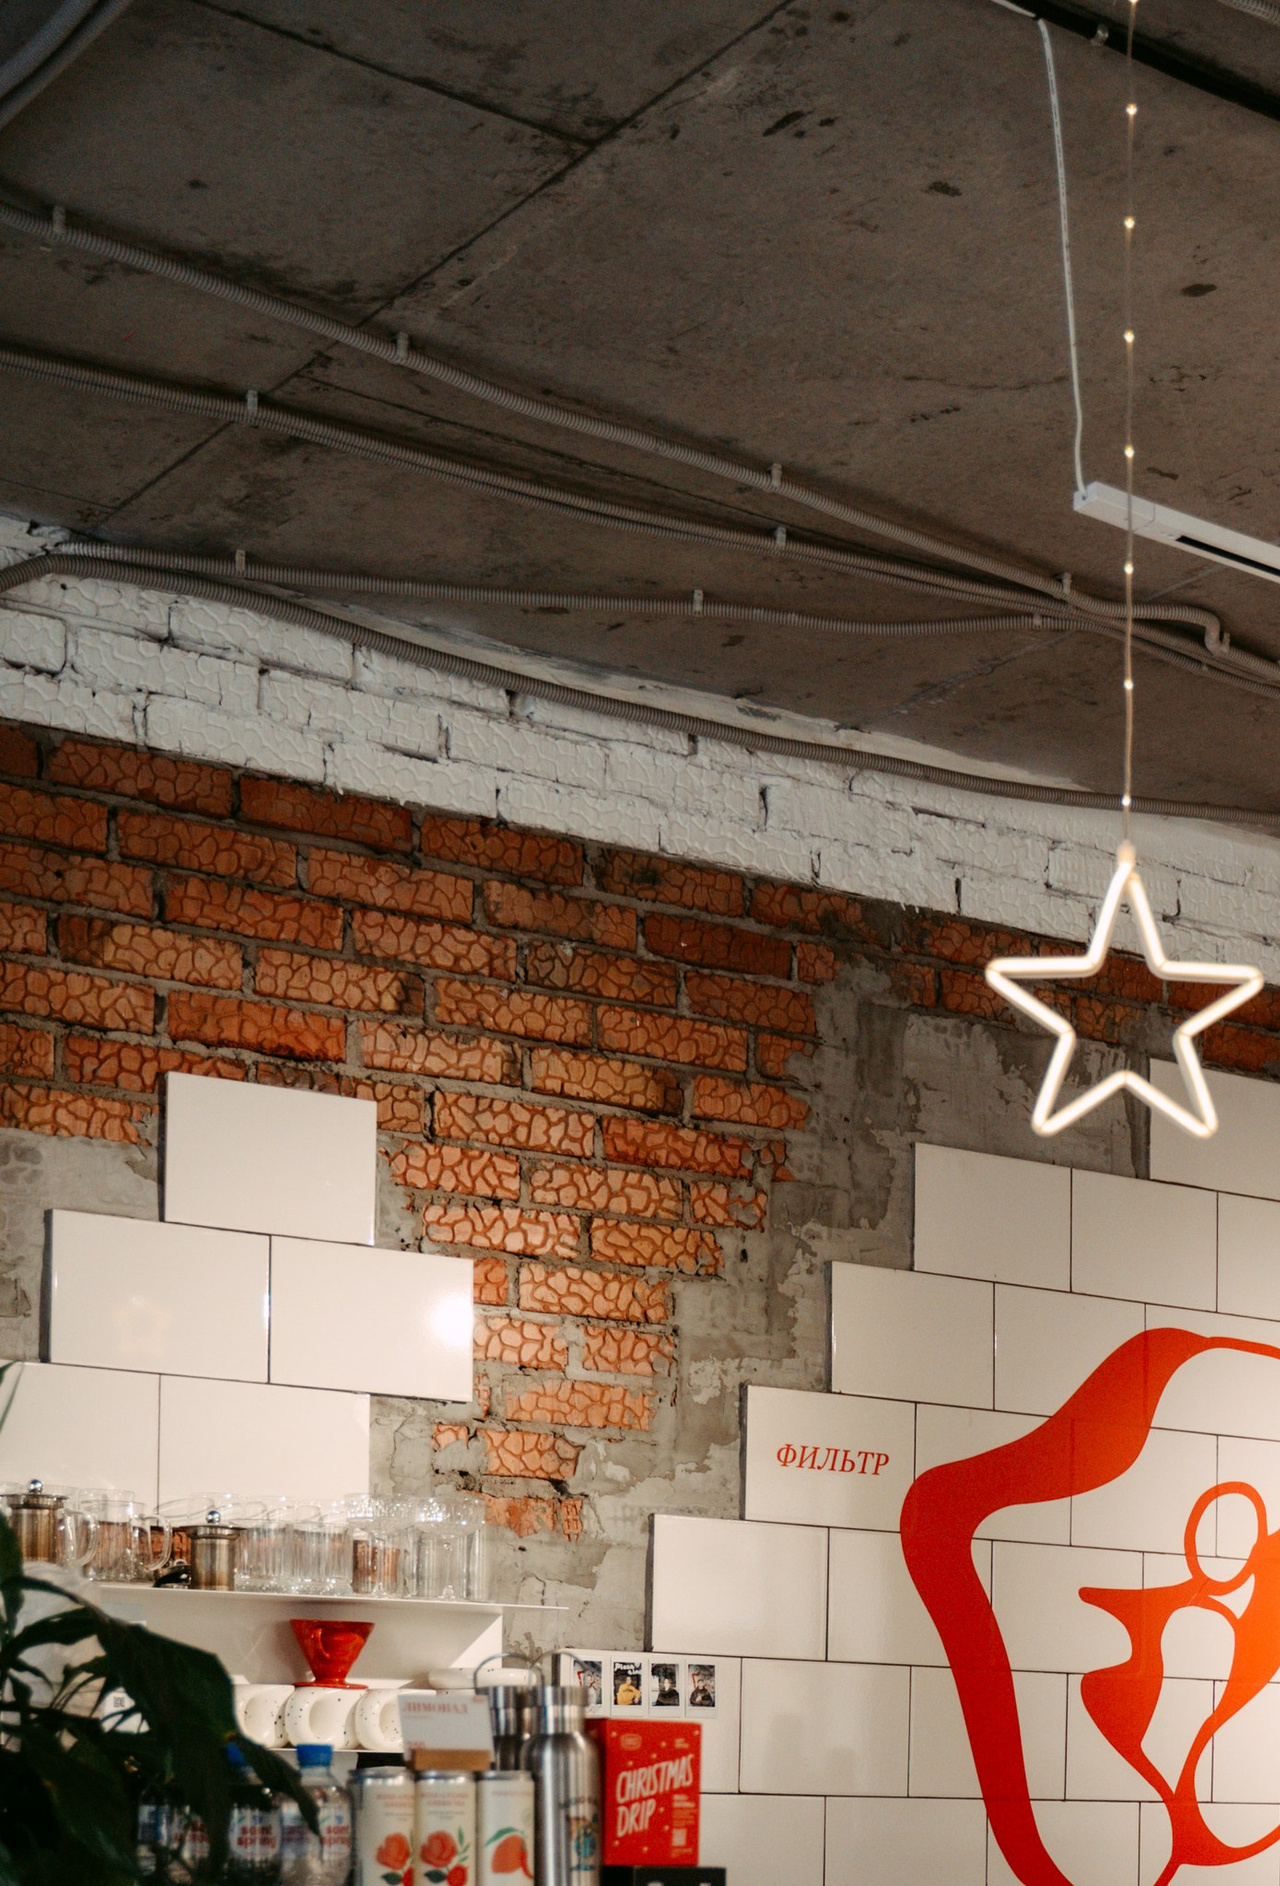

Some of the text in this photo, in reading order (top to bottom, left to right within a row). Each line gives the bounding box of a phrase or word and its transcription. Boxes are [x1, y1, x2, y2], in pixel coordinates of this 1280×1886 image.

[776, 1443, 890, 1476] ФИЛЬТР
[616, 1753, 694, 1804] CHRISTMAS
[616, 1798, 657, 1838] DRIP
